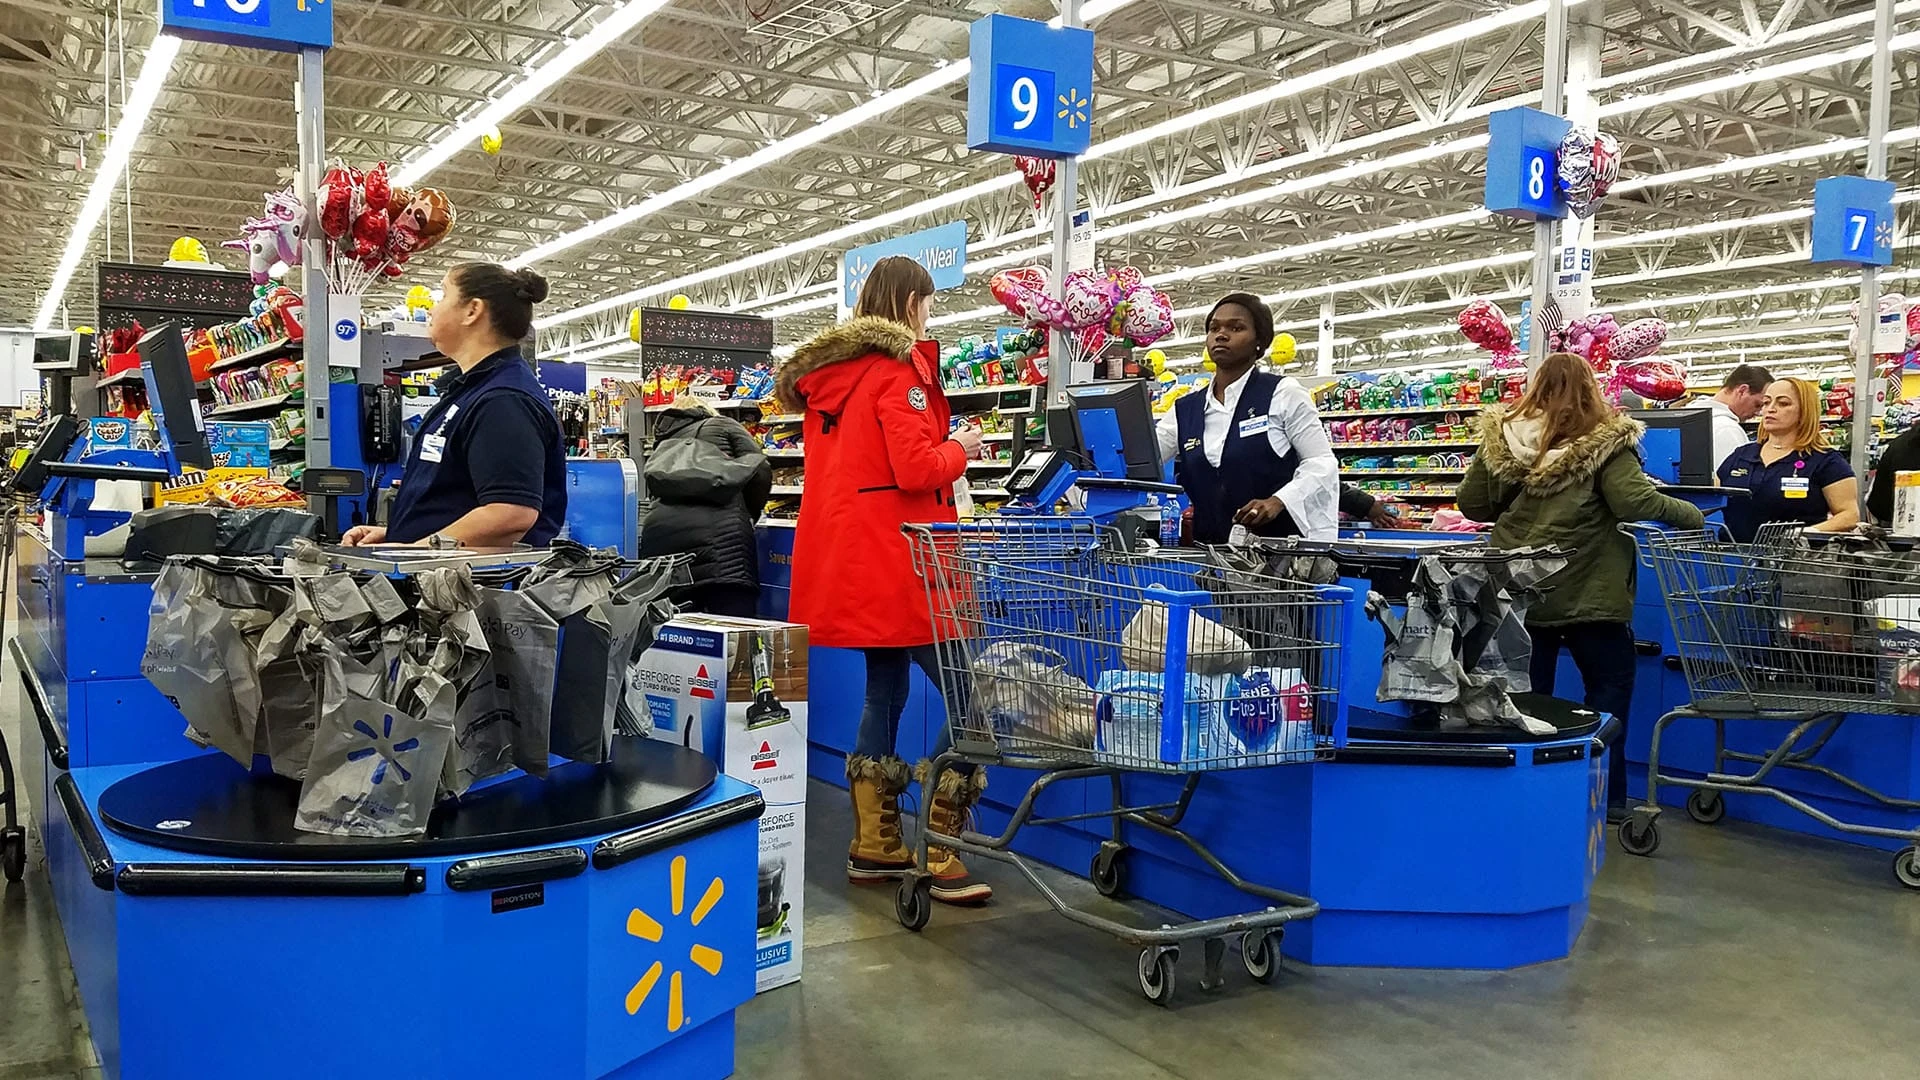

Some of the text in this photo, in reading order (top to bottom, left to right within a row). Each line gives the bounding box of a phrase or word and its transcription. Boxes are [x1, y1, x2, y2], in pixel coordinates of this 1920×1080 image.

[1011, 77, 1038, 130] 9
[1026, 159, 1053, 178] DAY
[1529, 156, 1545, 200] 8
[1850, 214, 1868, 251] 7
[925, 245, 959, 271] Wear
[504, 623, 528, 640] Pay
[668, 634, 694, 645] BRAND
[643, 682, 680, 694] TURBO REWIND
[504, 891, 541, 904] ROYSTON
[756, 945, 788, 962] LUSIVE
